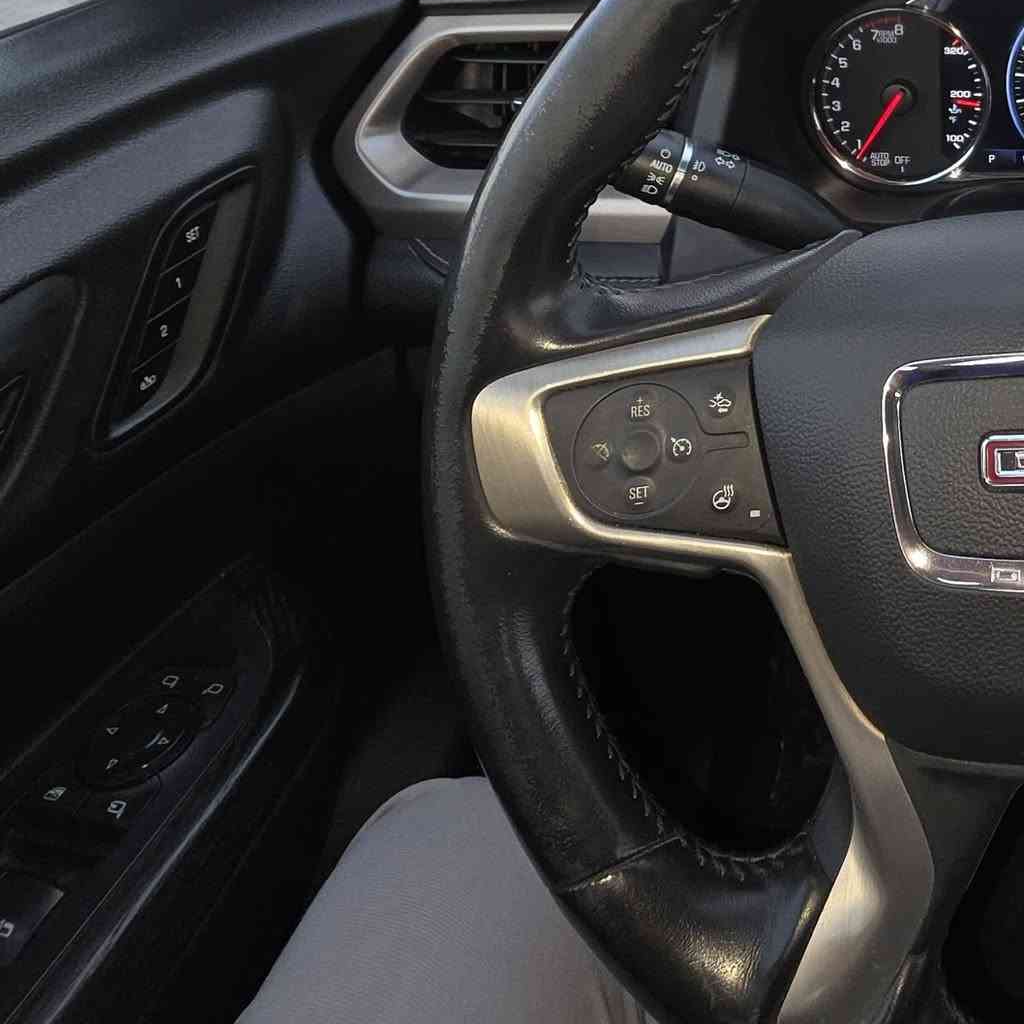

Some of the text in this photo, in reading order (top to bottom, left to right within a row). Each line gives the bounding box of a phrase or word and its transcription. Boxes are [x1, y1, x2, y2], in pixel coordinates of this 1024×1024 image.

[871, 29, 880, 41] 7
[894, 24, 904, 36] 8
[852, 40, 861, 51] 6
[943, 47, 964, 56] 320
[838, 57, 848, 68] 5
[831, 77, 840, 88] 4
[950, 90, 971, 98] 200
[832, 101, 841, 112] 3
[841, 121, 850, 132] 2
[946, 134, 965, 143] 100
[870, 152, 889, 160] AUTO
[894, 156, 911, 164] OFF
[988, 154, 995, 163] P
[650, 159, 673, 174] AUTO
[871, 159, 890, 167] STOP
[185, 226, 200, 243] SET
[176, 277, 182, 288] 1
[160, 324, 168, 338] 2
[631, 404, 650, 418] RES
[629, 486, 649, 500] SET
